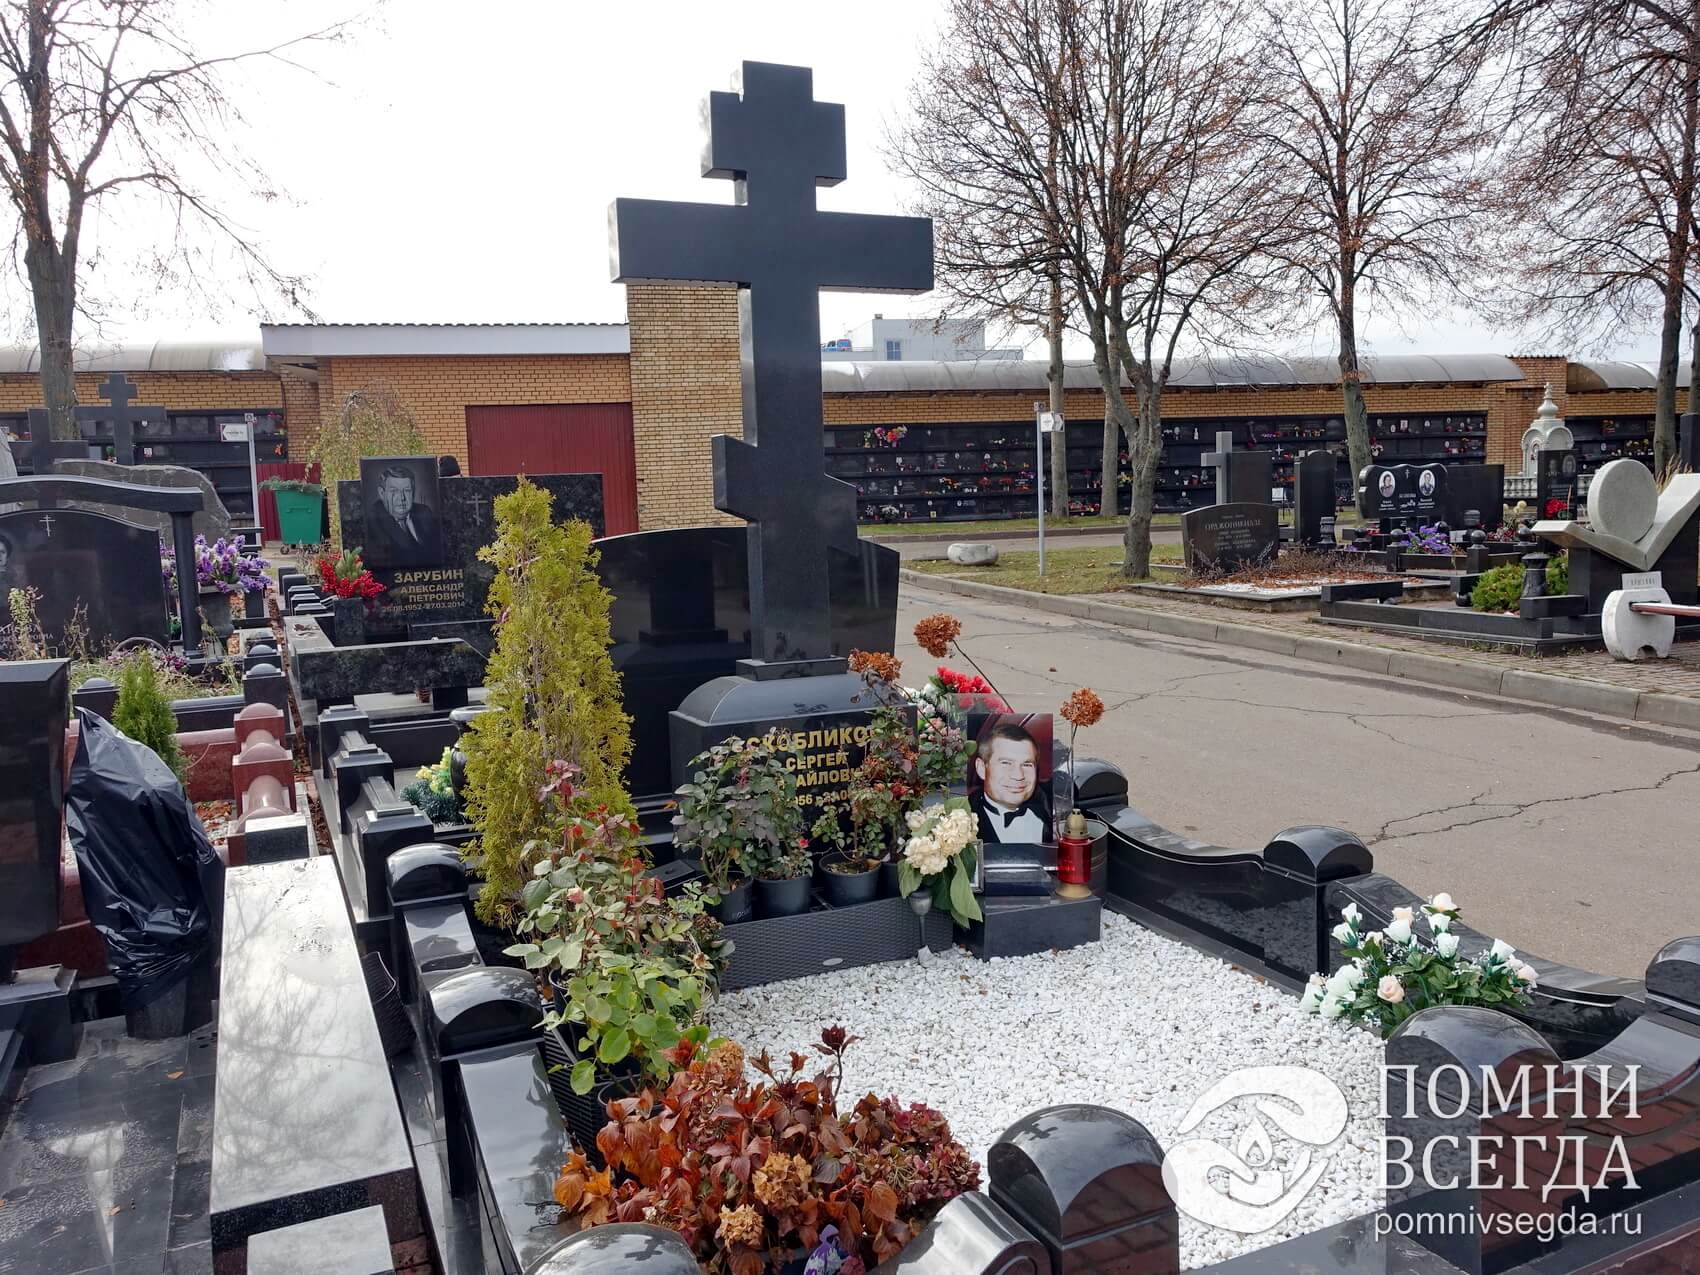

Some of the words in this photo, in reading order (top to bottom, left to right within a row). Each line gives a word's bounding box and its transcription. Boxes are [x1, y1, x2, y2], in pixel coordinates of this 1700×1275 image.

[394, 568, 464, 583] ЗАРУБИН
[400, 582, 464, 594] АЛЕКСАНДР
[409, 592, 465, 603] ПЕТРОВИЧ
[746, 725, 876, 753] СКОБЛИКО
